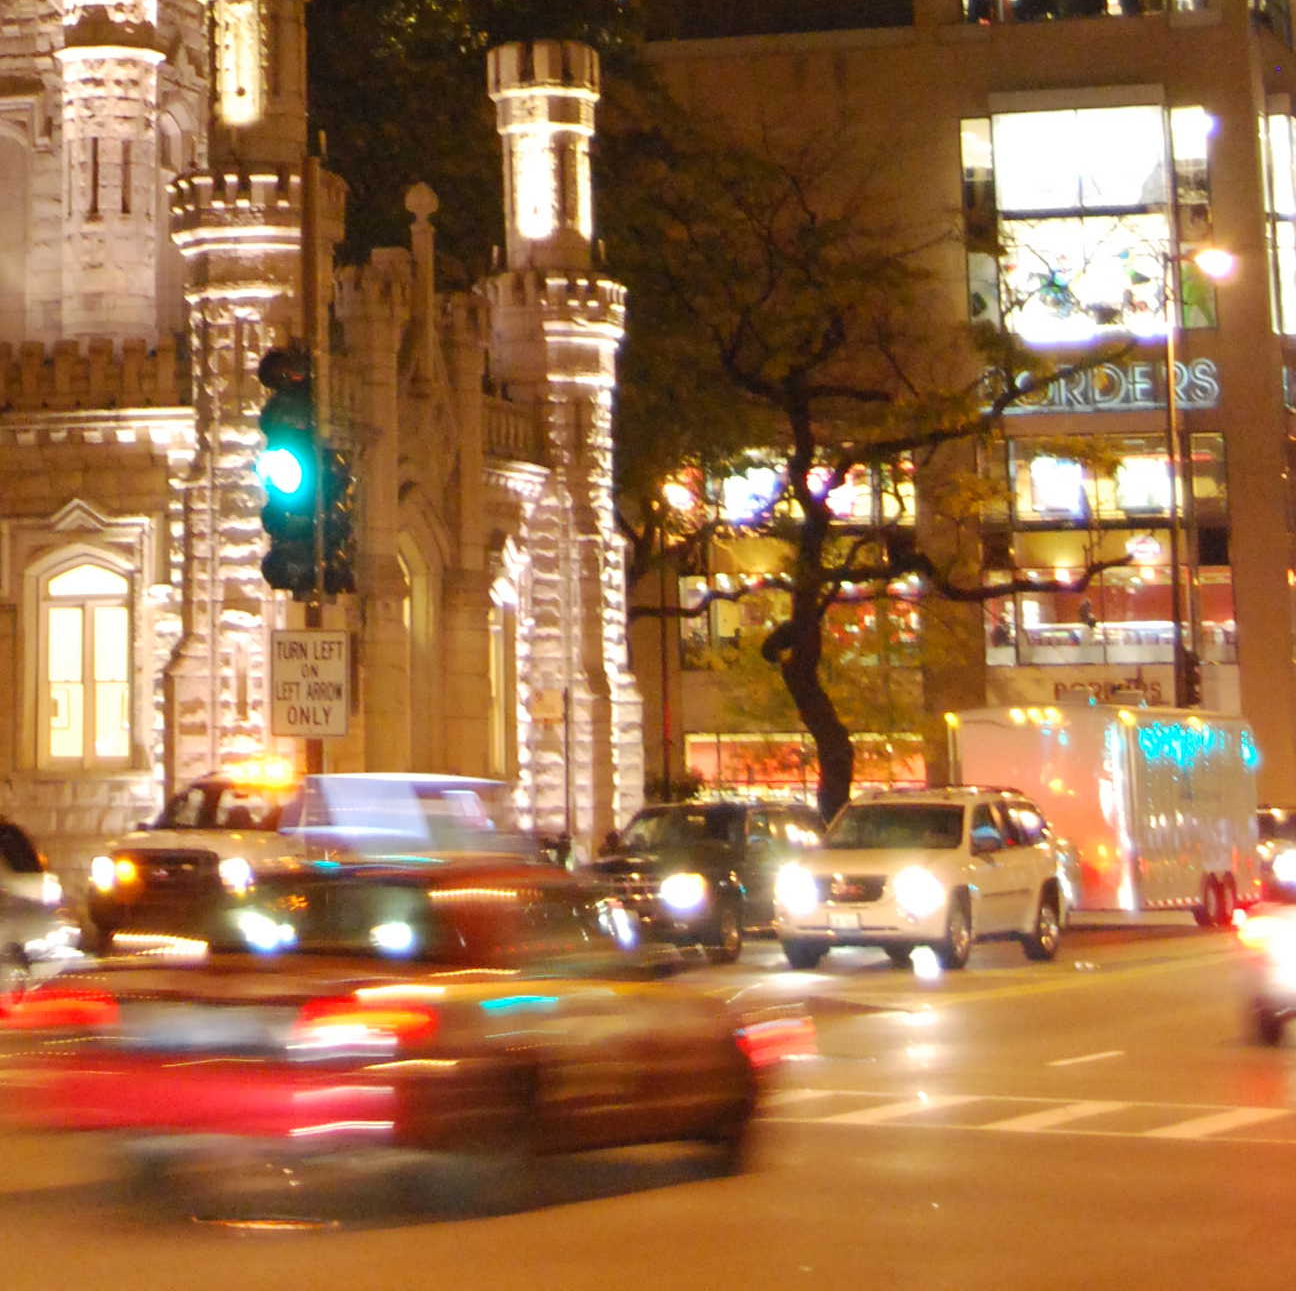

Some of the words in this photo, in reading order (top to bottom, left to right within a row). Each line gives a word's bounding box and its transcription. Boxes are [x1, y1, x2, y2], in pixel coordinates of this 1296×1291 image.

[277, 641, 307, 660] TURN
[313, 641, 342, 660] LEFT
[301, 665, 318, 678] ON
[276, 681, 301, 701] LEFT
[307, 681, 342, 702] ARROW
[287, 706, 332, 726] ONLY
